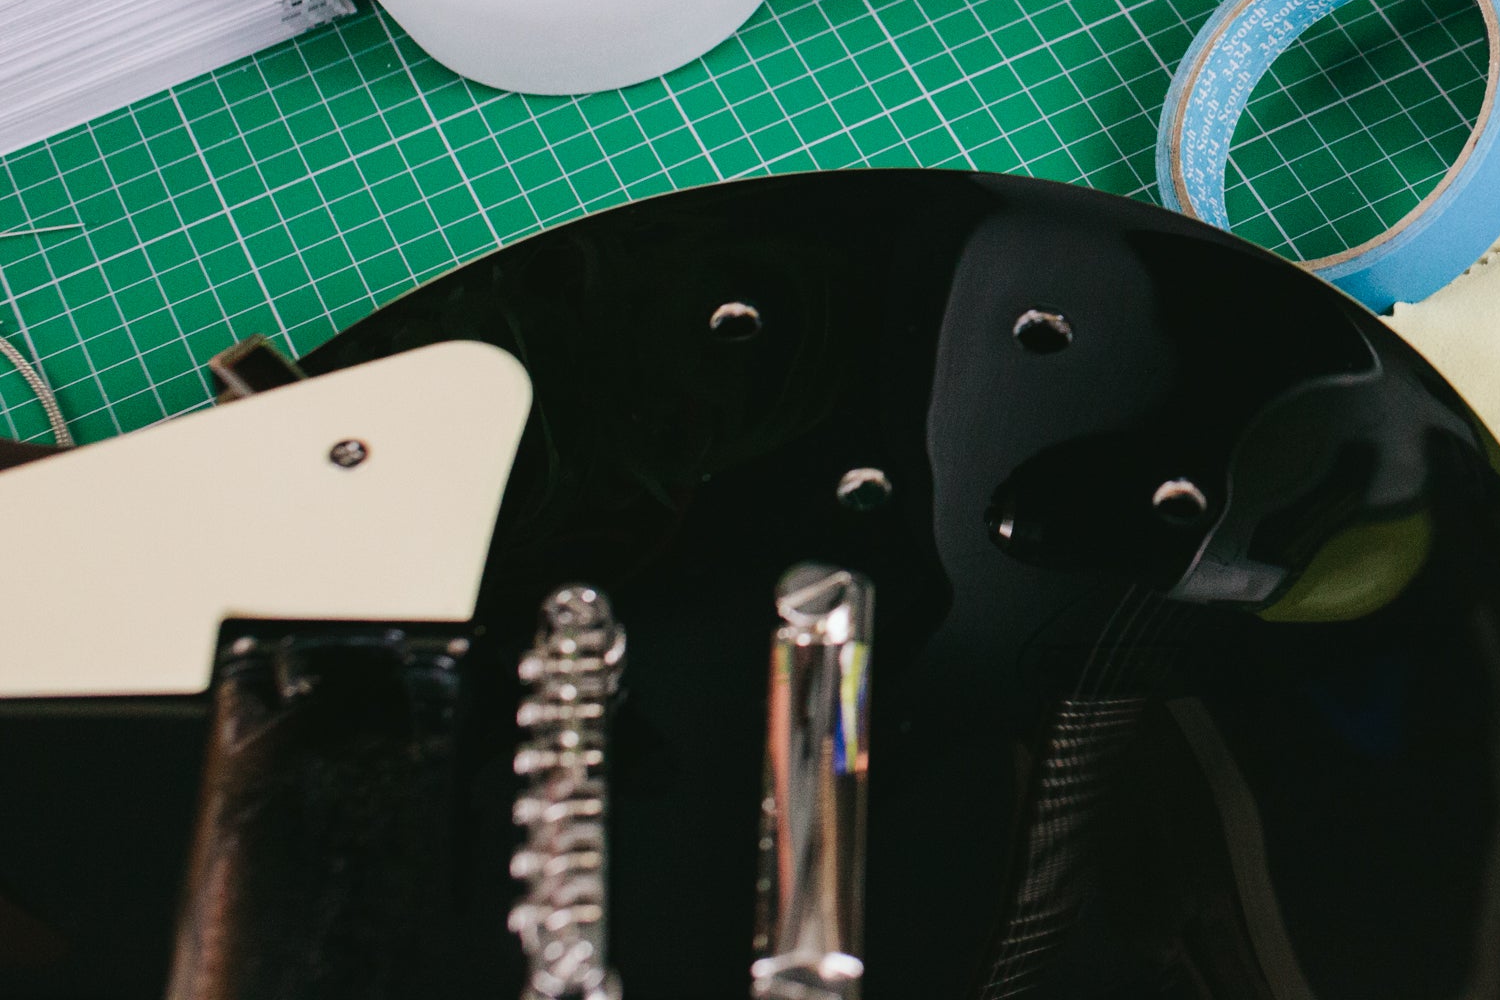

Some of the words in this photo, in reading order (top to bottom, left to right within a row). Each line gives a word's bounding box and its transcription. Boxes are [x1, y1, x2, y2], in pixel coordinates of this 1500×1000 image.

[1259, 20, 1293, 56] 3434
[1222, 41, 1252, 82] 3434
[1195, 69, 1217, 111] 3434
